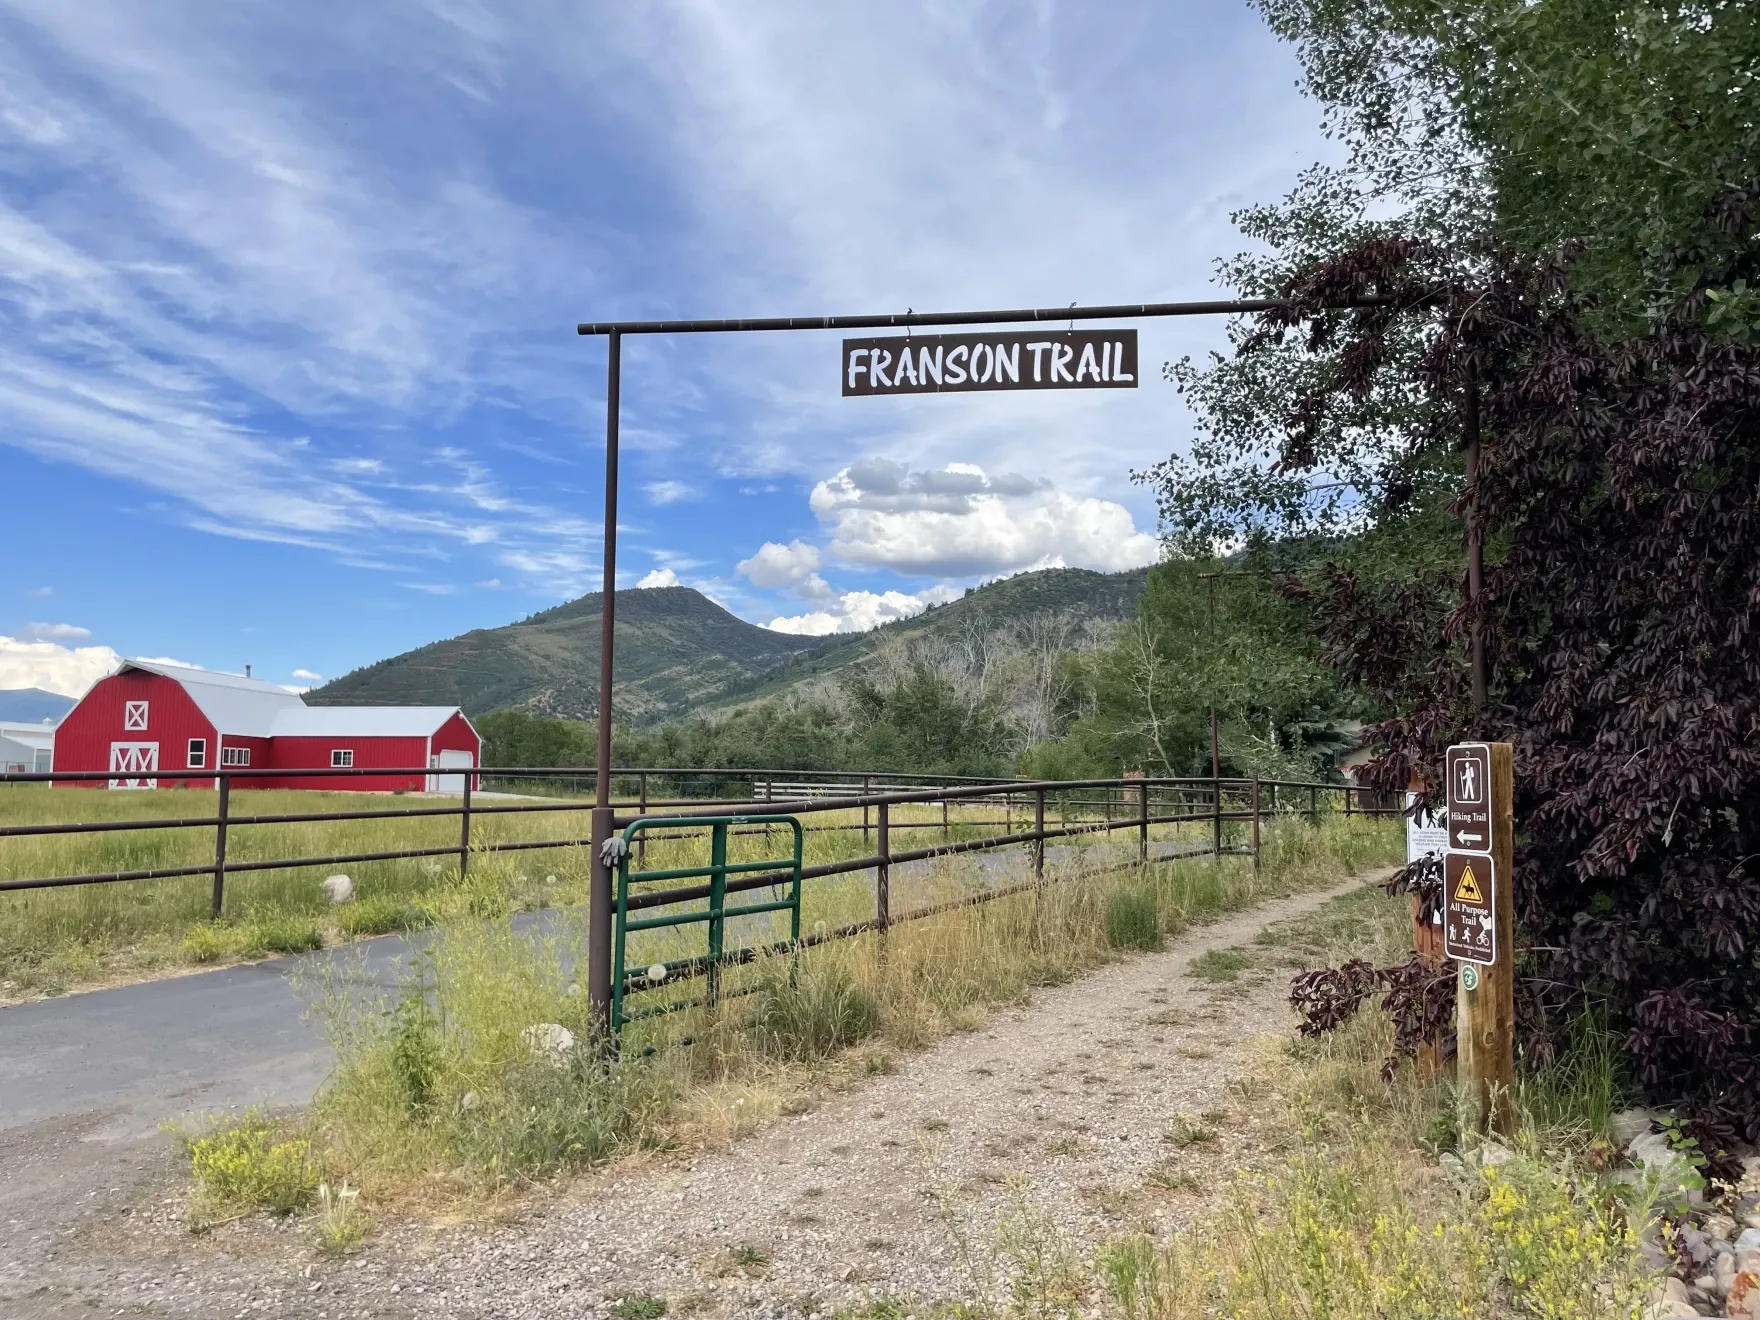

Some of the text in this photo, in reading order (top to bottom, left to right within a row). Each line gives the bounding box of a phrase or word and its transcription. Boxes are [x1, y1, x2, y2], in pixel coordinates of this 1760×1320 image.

[848, 341, 1134, 388] FRANSON TRAIL
[1451, 811, 1487, 823] Hiking Trail
[1450, 902, 1489, 916] All Purpose
[1461, 914, 1477, 926] Trail
